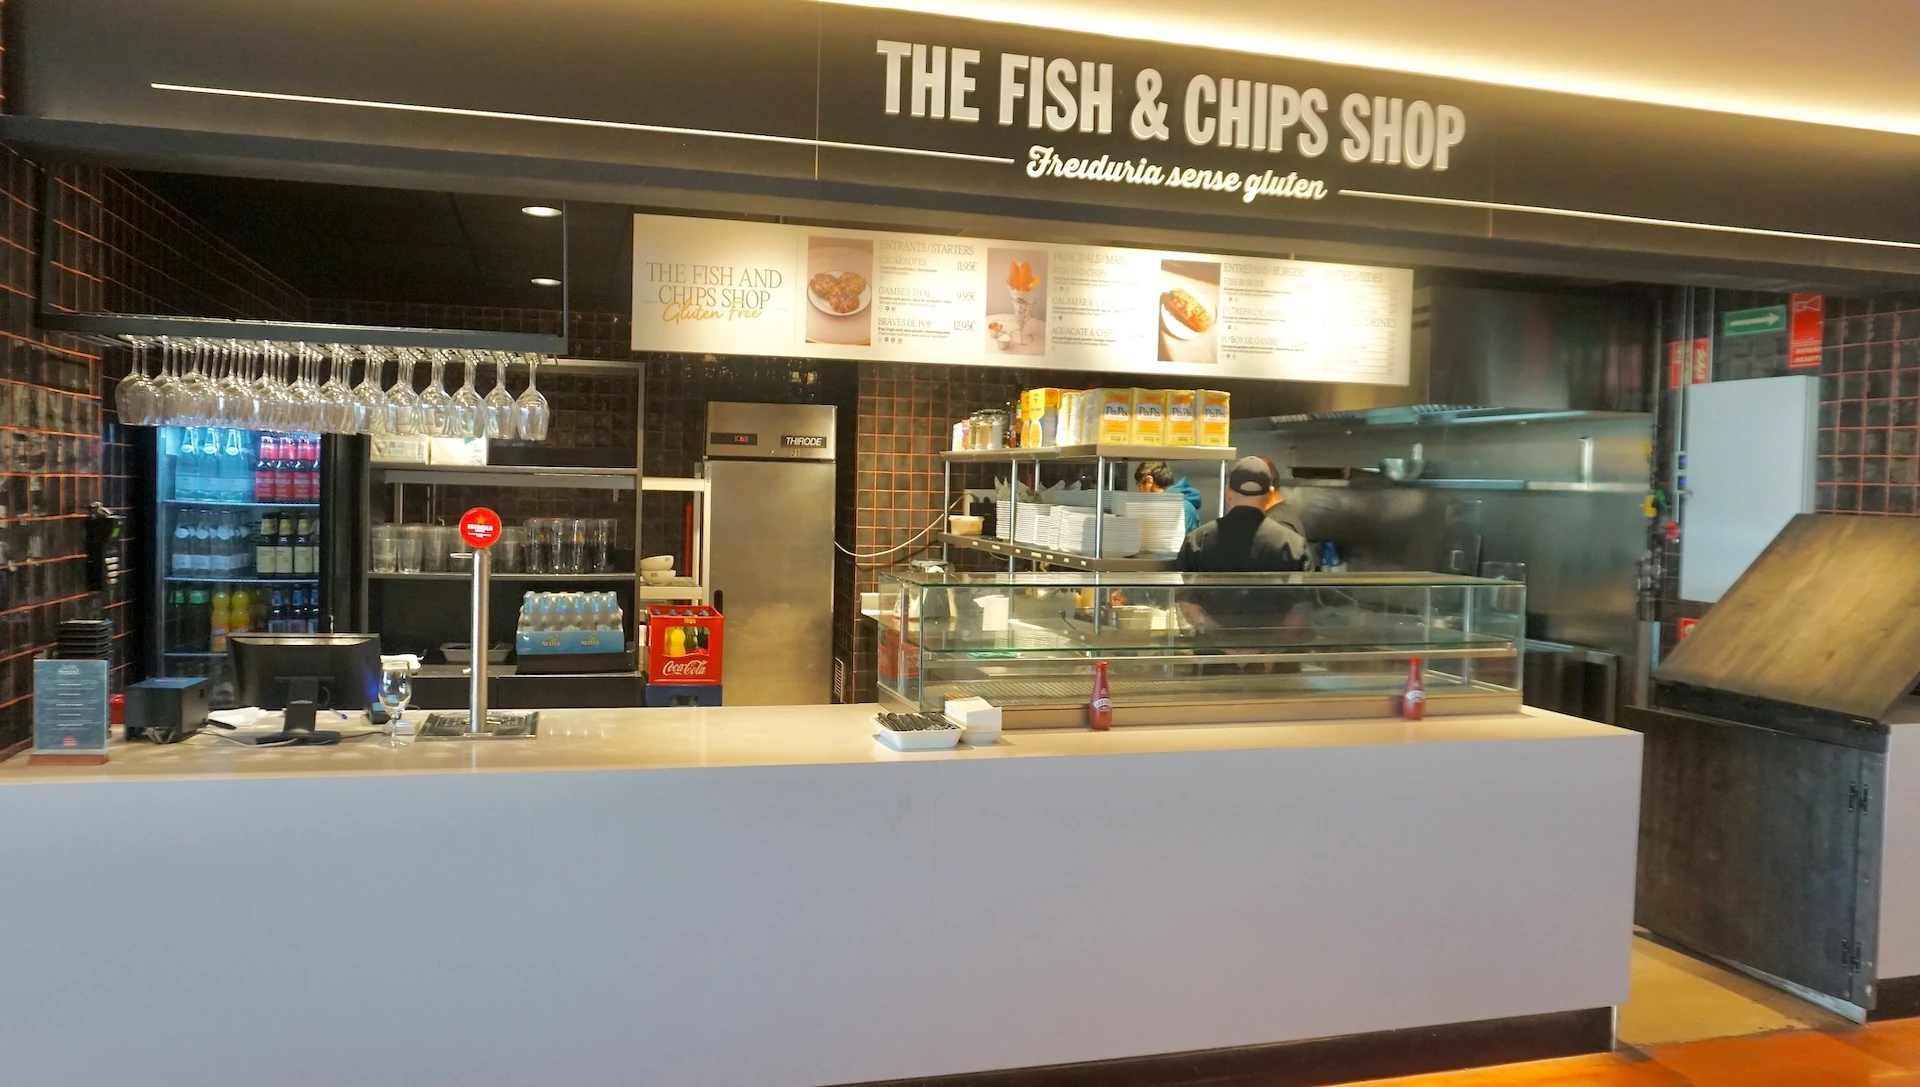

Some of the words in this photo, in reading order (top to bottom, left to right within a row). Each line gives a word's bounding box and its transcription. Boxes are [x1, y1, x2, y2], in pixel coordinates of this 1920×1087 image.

[876, 39, 981, 121] THE
[998, 52, 1113, 135] FISH
[1130, 67, 1169, 142] &
[1184, 74, 1329, 158] CHIPS
[1340, 93, 1466, 171] SHOP
[1026, 145, 1163, 186] Freiduria
[1163, 166, 1241, 193] sense
[1242, 170, 1327, 204] gluten
[646, 261, 687, 284] THE
[692, 264, 734, 286] FISH
[738, 267, 783, 289] AND
[658, 285, 717, 307] CHIPS
[721, 288, 771, 310] SHOP
[662, 298, 724, 325] Gluten
[728, 300, 762, 322] Free
[786, 437, 822, 446] THIRODE
[662, 659, 709, 676] Coca-Cola
